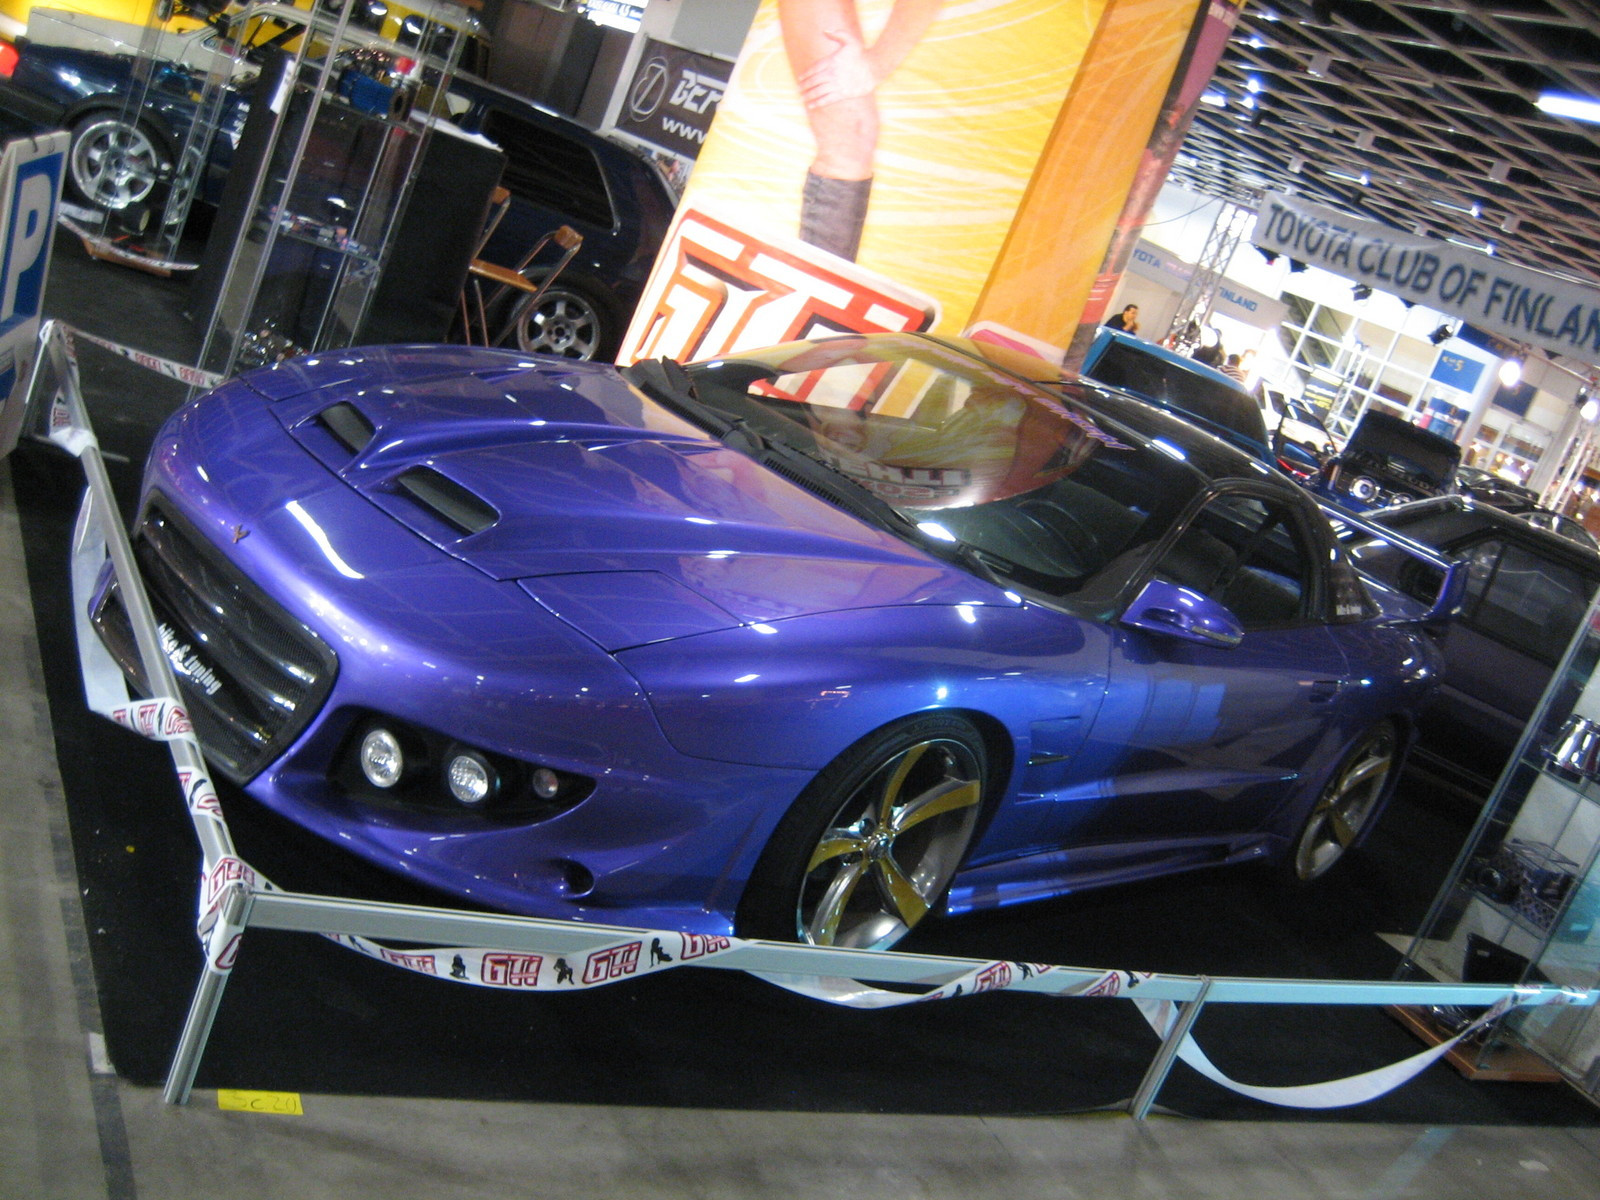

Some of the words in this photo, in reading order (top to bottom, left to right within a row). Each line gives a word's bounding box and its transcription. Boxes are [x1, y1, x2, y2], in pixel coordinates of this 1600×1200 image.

[1264, 203, 1355, 267] TOYOTA
[1357, 238, 1441, 294] CLUB
[1440, 263, 1488, 307] OF
